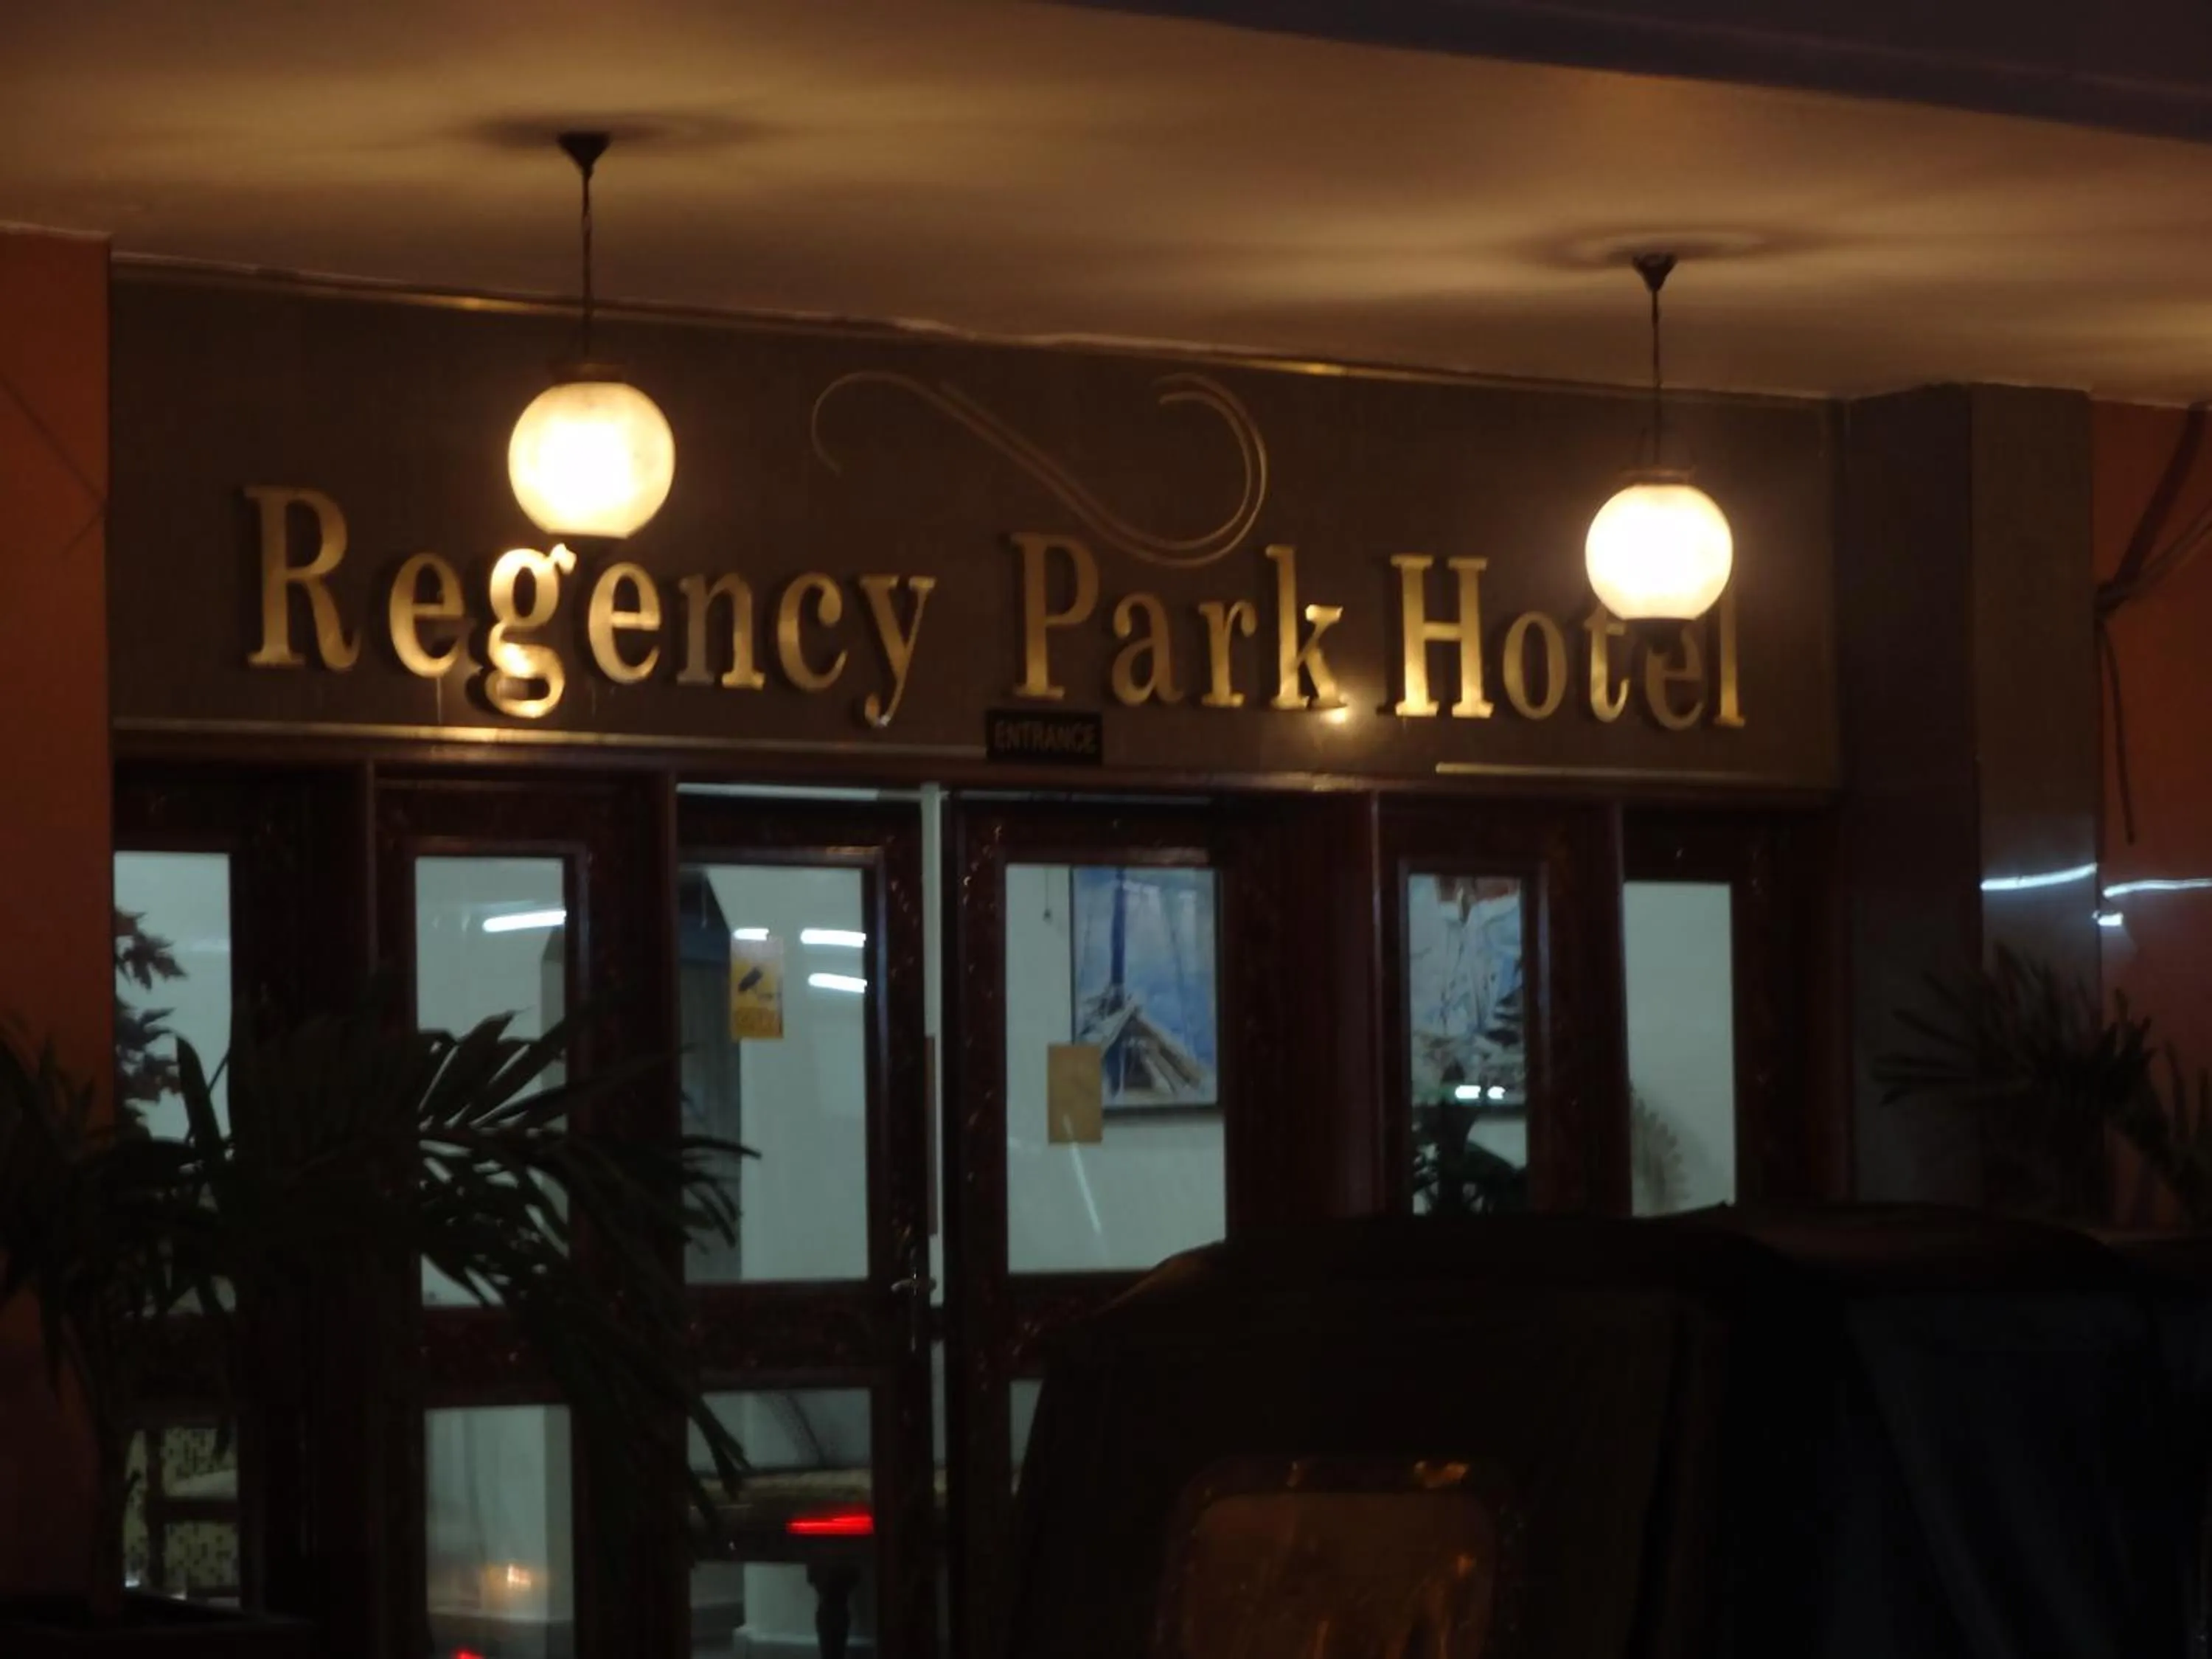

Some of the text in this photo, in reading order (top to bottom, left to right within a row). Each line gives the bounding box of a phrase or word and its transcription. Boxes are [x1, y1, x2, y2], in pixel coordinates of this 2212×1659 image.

[243, 485, 1745, 730] Regency Park Hotel
[993, 720, 1097, 754] ENTRANCE
